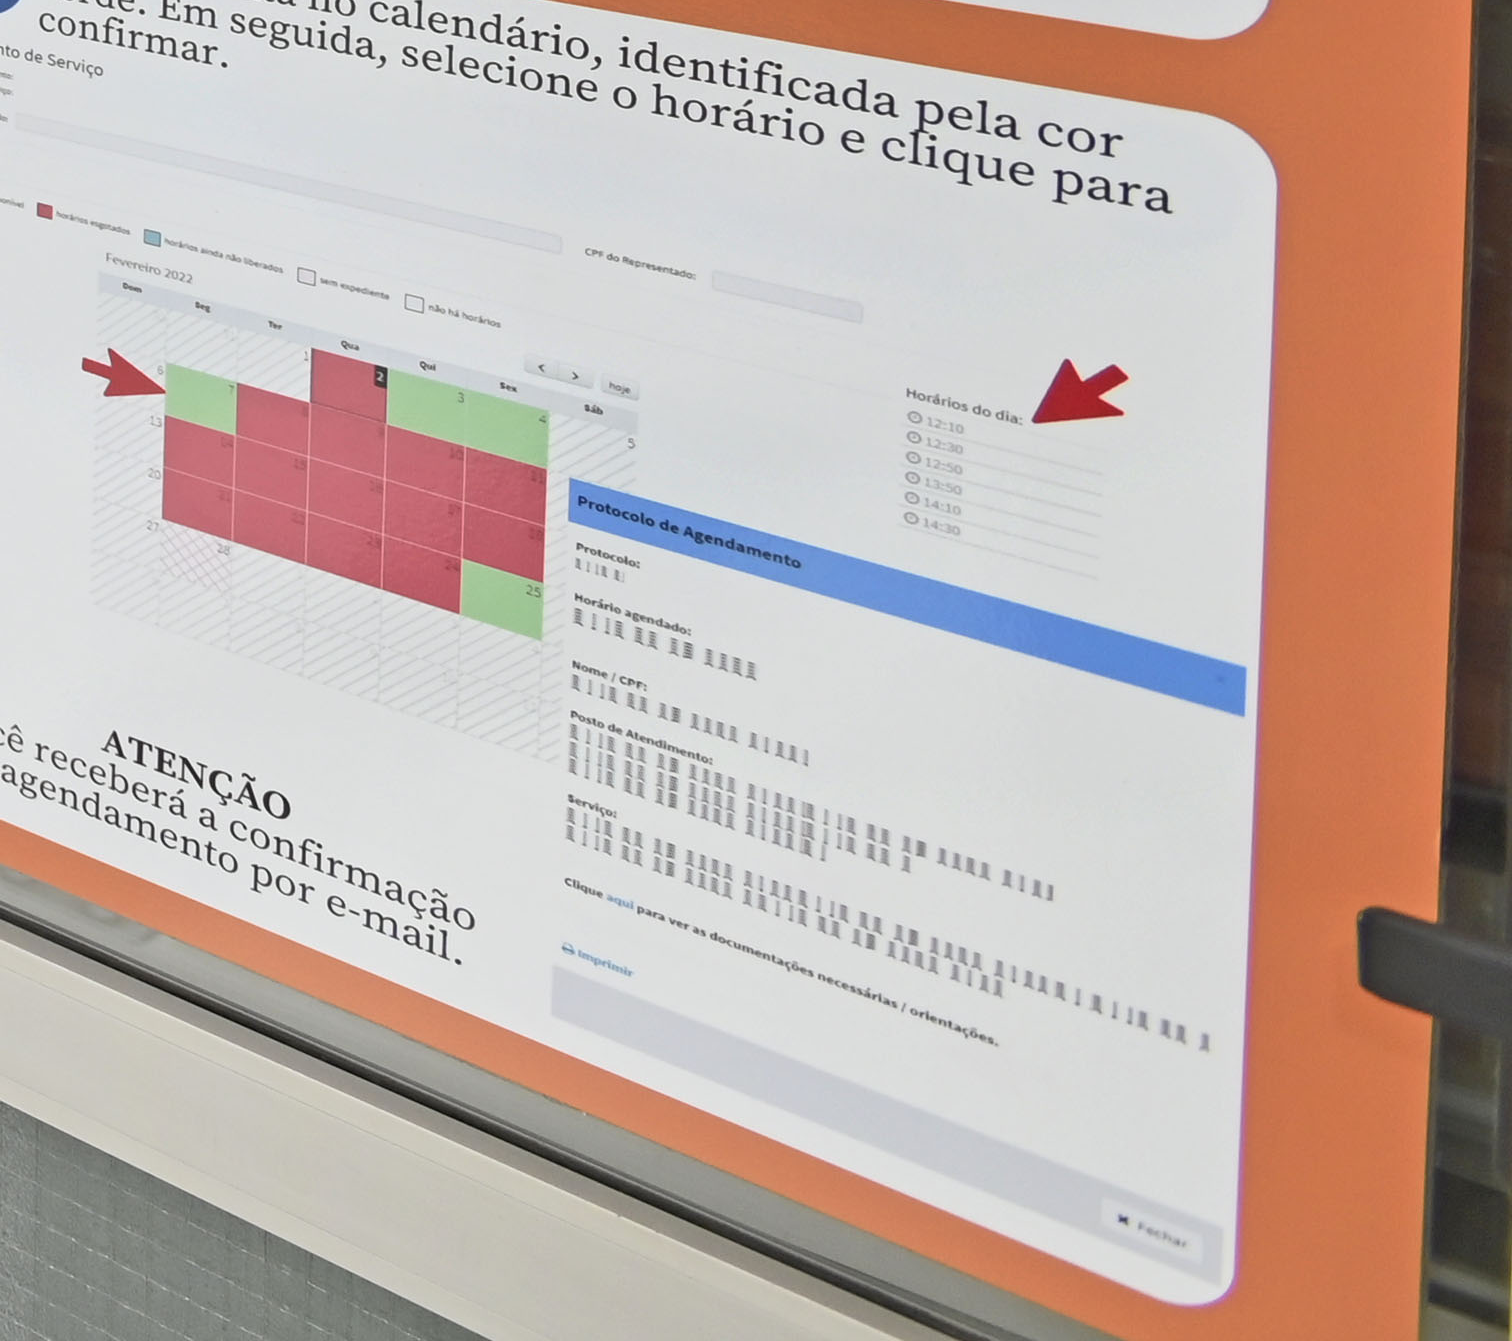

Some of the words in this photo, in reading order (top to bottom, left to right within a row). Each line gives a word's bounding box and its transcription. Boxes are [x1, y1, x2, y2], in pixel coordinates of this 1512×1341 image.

[39, 12, 228, 69] confirmar.
[24, 48, 43, 64] de
[47, 53, 104, 79] Serviço
[105, 252, 162, 276] Fevereiro
[164, 267, 193, 285] 2022
[906, 387, 969, 413] Horários
[971, 404, 992, 418] do
[995, 409, 1023, 426] dia:
[927, 416, 965, 434] 12:10
[926, 437, 964, 455] 12:30
[926, 457, 963, 475] 12:50
[925, 477, 962, 496] 13:50
[924, 497, 962, 516] 14:10
[577, 495, 655, 527] Protocolo
[659, 519, 679, 535] de
[682, 526, 802, 569] Agendamento
[923, 518, 961, 536] 14:30
[101, 730, 291, 820] ATENÇÃO
[1, 764, 238, 874] agendamento
[250, 863, 316, 904] por
[327, 895, 462, 966] e-mail.
